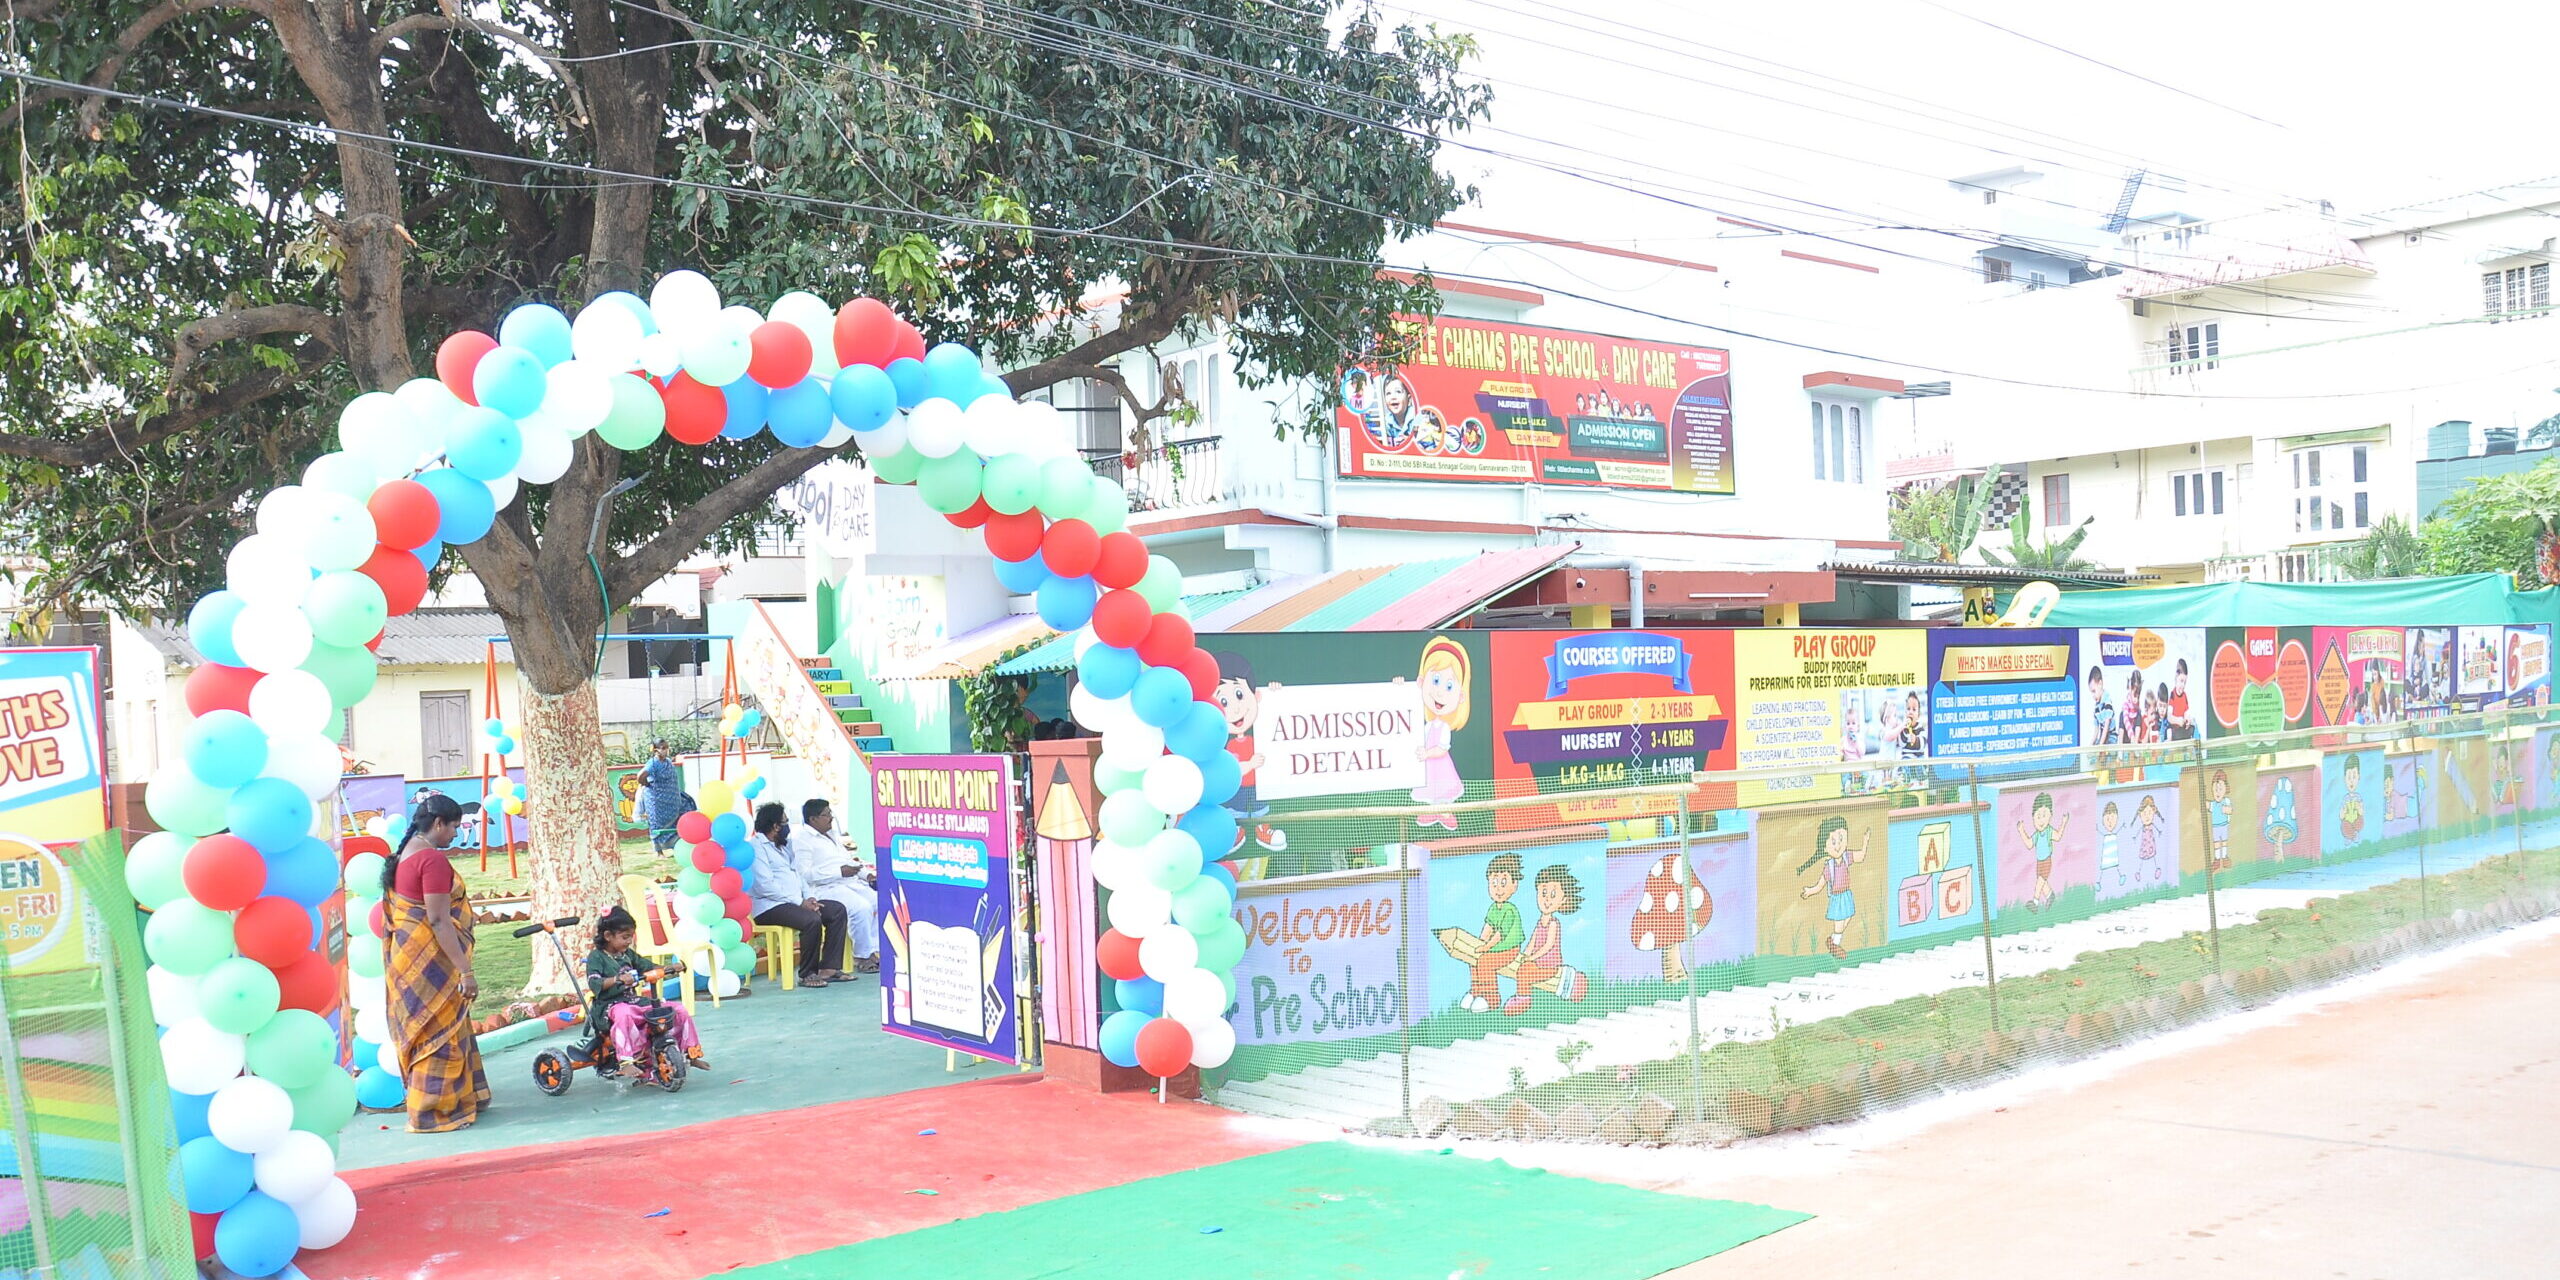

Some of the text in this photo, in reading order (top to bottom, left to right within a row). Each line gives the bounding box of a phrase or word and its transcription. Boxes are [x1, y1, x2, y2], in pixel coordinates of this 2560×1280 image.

[1442, 327, 1678, 389] CHARMS PRE SCHOOL & DAY CARE
[1490, 384, 1532, 394] PLAY GROUP
[1498, 400, 1530, 410] NURSERY
[1516, 434, 1550, 443] DAY CARE
[1578, 424, 1655, 441] ADMISSION OPEN
[844, 484, 866, 511] DAY
[842, 513, 869, 541] CARE
[1965, 599, 1979, 622] A
[1563, 646, 1676, 667] COURSES OFFERED
[1794, 635, 1876, 659] PLAY GROUP
[2102, 640, 2132, 657] NURSERY
[2249, 639, 2274, 656] GAMES
[1804, 661, 1867, 674] BUDDY PROGRAM
[1957, 654, 2054, 671] WHAT'S MAKES US SPECIAL
[2507, 633, 2521, 691] 6
[1750, 673, 1916, 691] PREPARING FOR BEST SOCIAL & CULTURAL LIFE
[1558, 704, 1584, 721] PLAY
[1587, 703, 1623, 720] GROUP
[1651, 703, 1656, 719] 2
[1661, 703, 1666, 719] 3
[1667, 702, 1693, 718] YEARS
[1752, 703, 1780, 714] LEARNING
[1781, 702, 1793, 713] AND
[1272, 709, 1412, 742] ADMISSION
[1746, 719, 1763, 730] CHILD
[1764, 716, 1804, 729] DEVELOPMENT
[1561, 732, 1622, 751] NURSERY
[1651, 731, 1657, 748] 3
[1661, 730, 1667, 748] 4
[1668, 729, 1694, 747] YEARS
[1756, 734, 1759, 744] A
[1761, 732, 1791, 744] SCIENTIFIC
[1290, 748, 1391, 776] DETAIL
[1740, 745, 1838, 762] THIS PROGRAM WILL FOSTER SOCIAL
[1651, 759, 1657, 775] 4
[1662, 759, 1668, 775] 6
[1668, 757, 1694, 773] YEARS
[877, 768, 999, 812] SR TUITION POINT
[887, 811, 912, 831] (STATE
[945, 814, 989, 837] SYLLABUS)
[1924, 838, 1940, 872] A
[17, 893, 56, 919] FRI
[1906, 881, 1961, 922] B C
[10, 924, 42, 938] 5 PM
[1282, 947, 1312, 975] To
[1251, 948, 1404, 1039] Pre School
